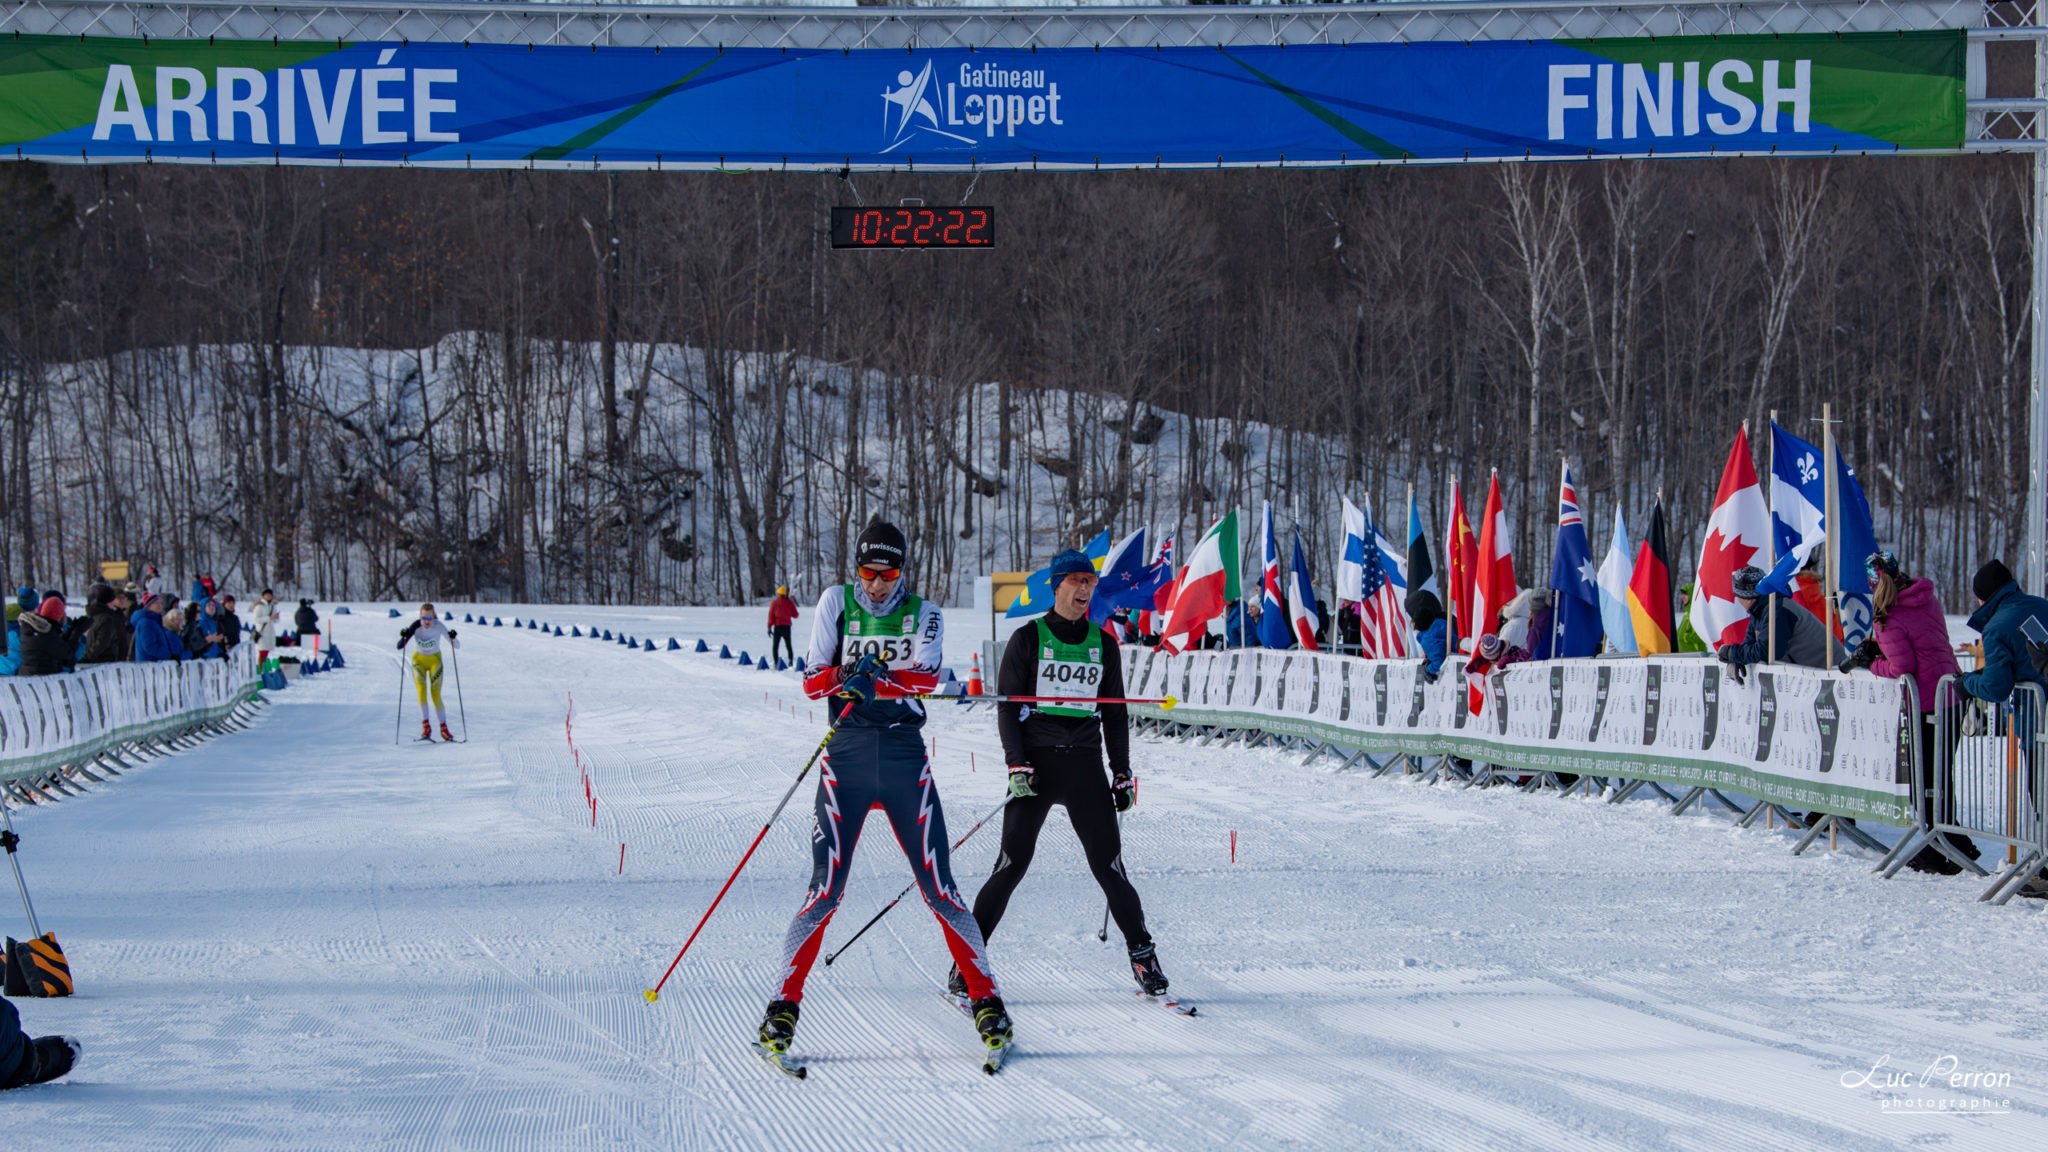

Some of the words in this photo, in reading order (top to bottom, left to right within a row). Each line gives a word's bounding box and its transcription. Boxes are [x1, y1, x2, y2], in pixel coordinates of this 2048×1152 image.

[960, 62, 1045, 88] Gatineau
[92, 48, 460, 145] ARRIVÉE
[948, 82, 1064, 137] Loppet
[1548, 59, 1812, 140] FINISH
[869, 543, 902, 556] swisscom
[921, 611, 940, 645] HALTI
[846, 638, 912, 663] 4053
[1041, 663, 1099, 685] 4048
